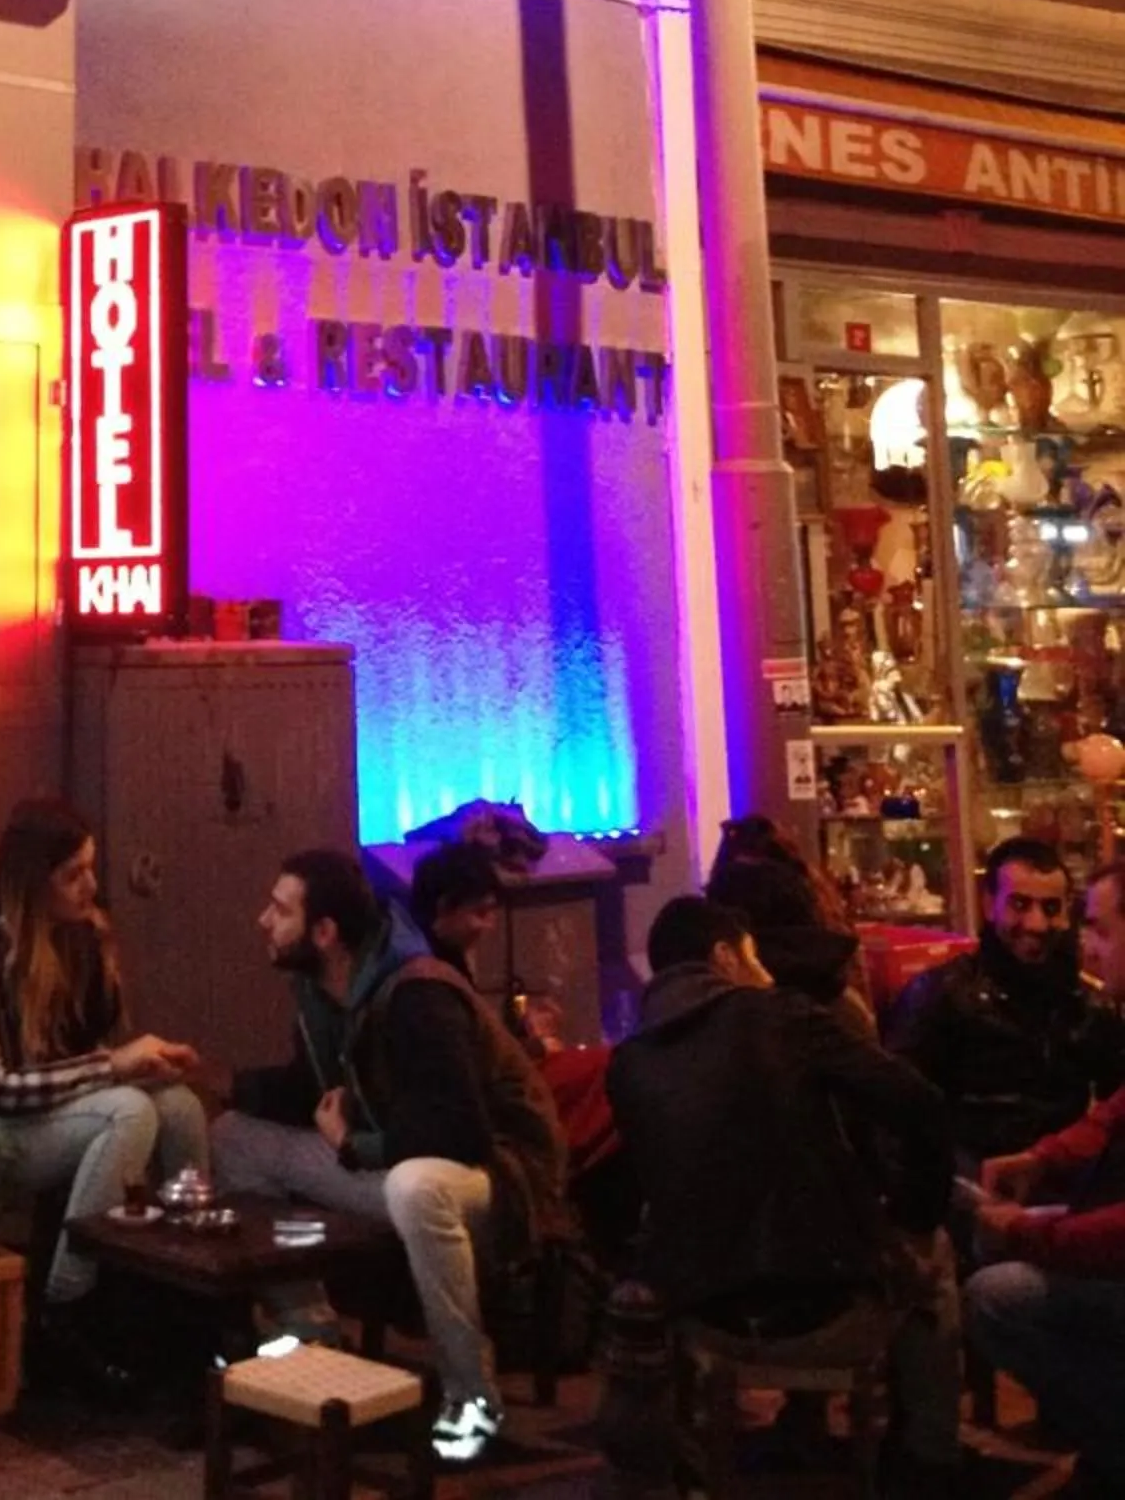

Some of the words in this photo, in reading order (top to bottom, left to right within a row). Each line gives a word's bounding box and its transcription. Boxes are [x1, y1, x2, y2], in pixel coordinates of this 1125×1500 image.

[759, 105, 927, 185] NES
[963, 142, 1125, 214] ANTI
[90, 222, 137, 548] HOTEL
